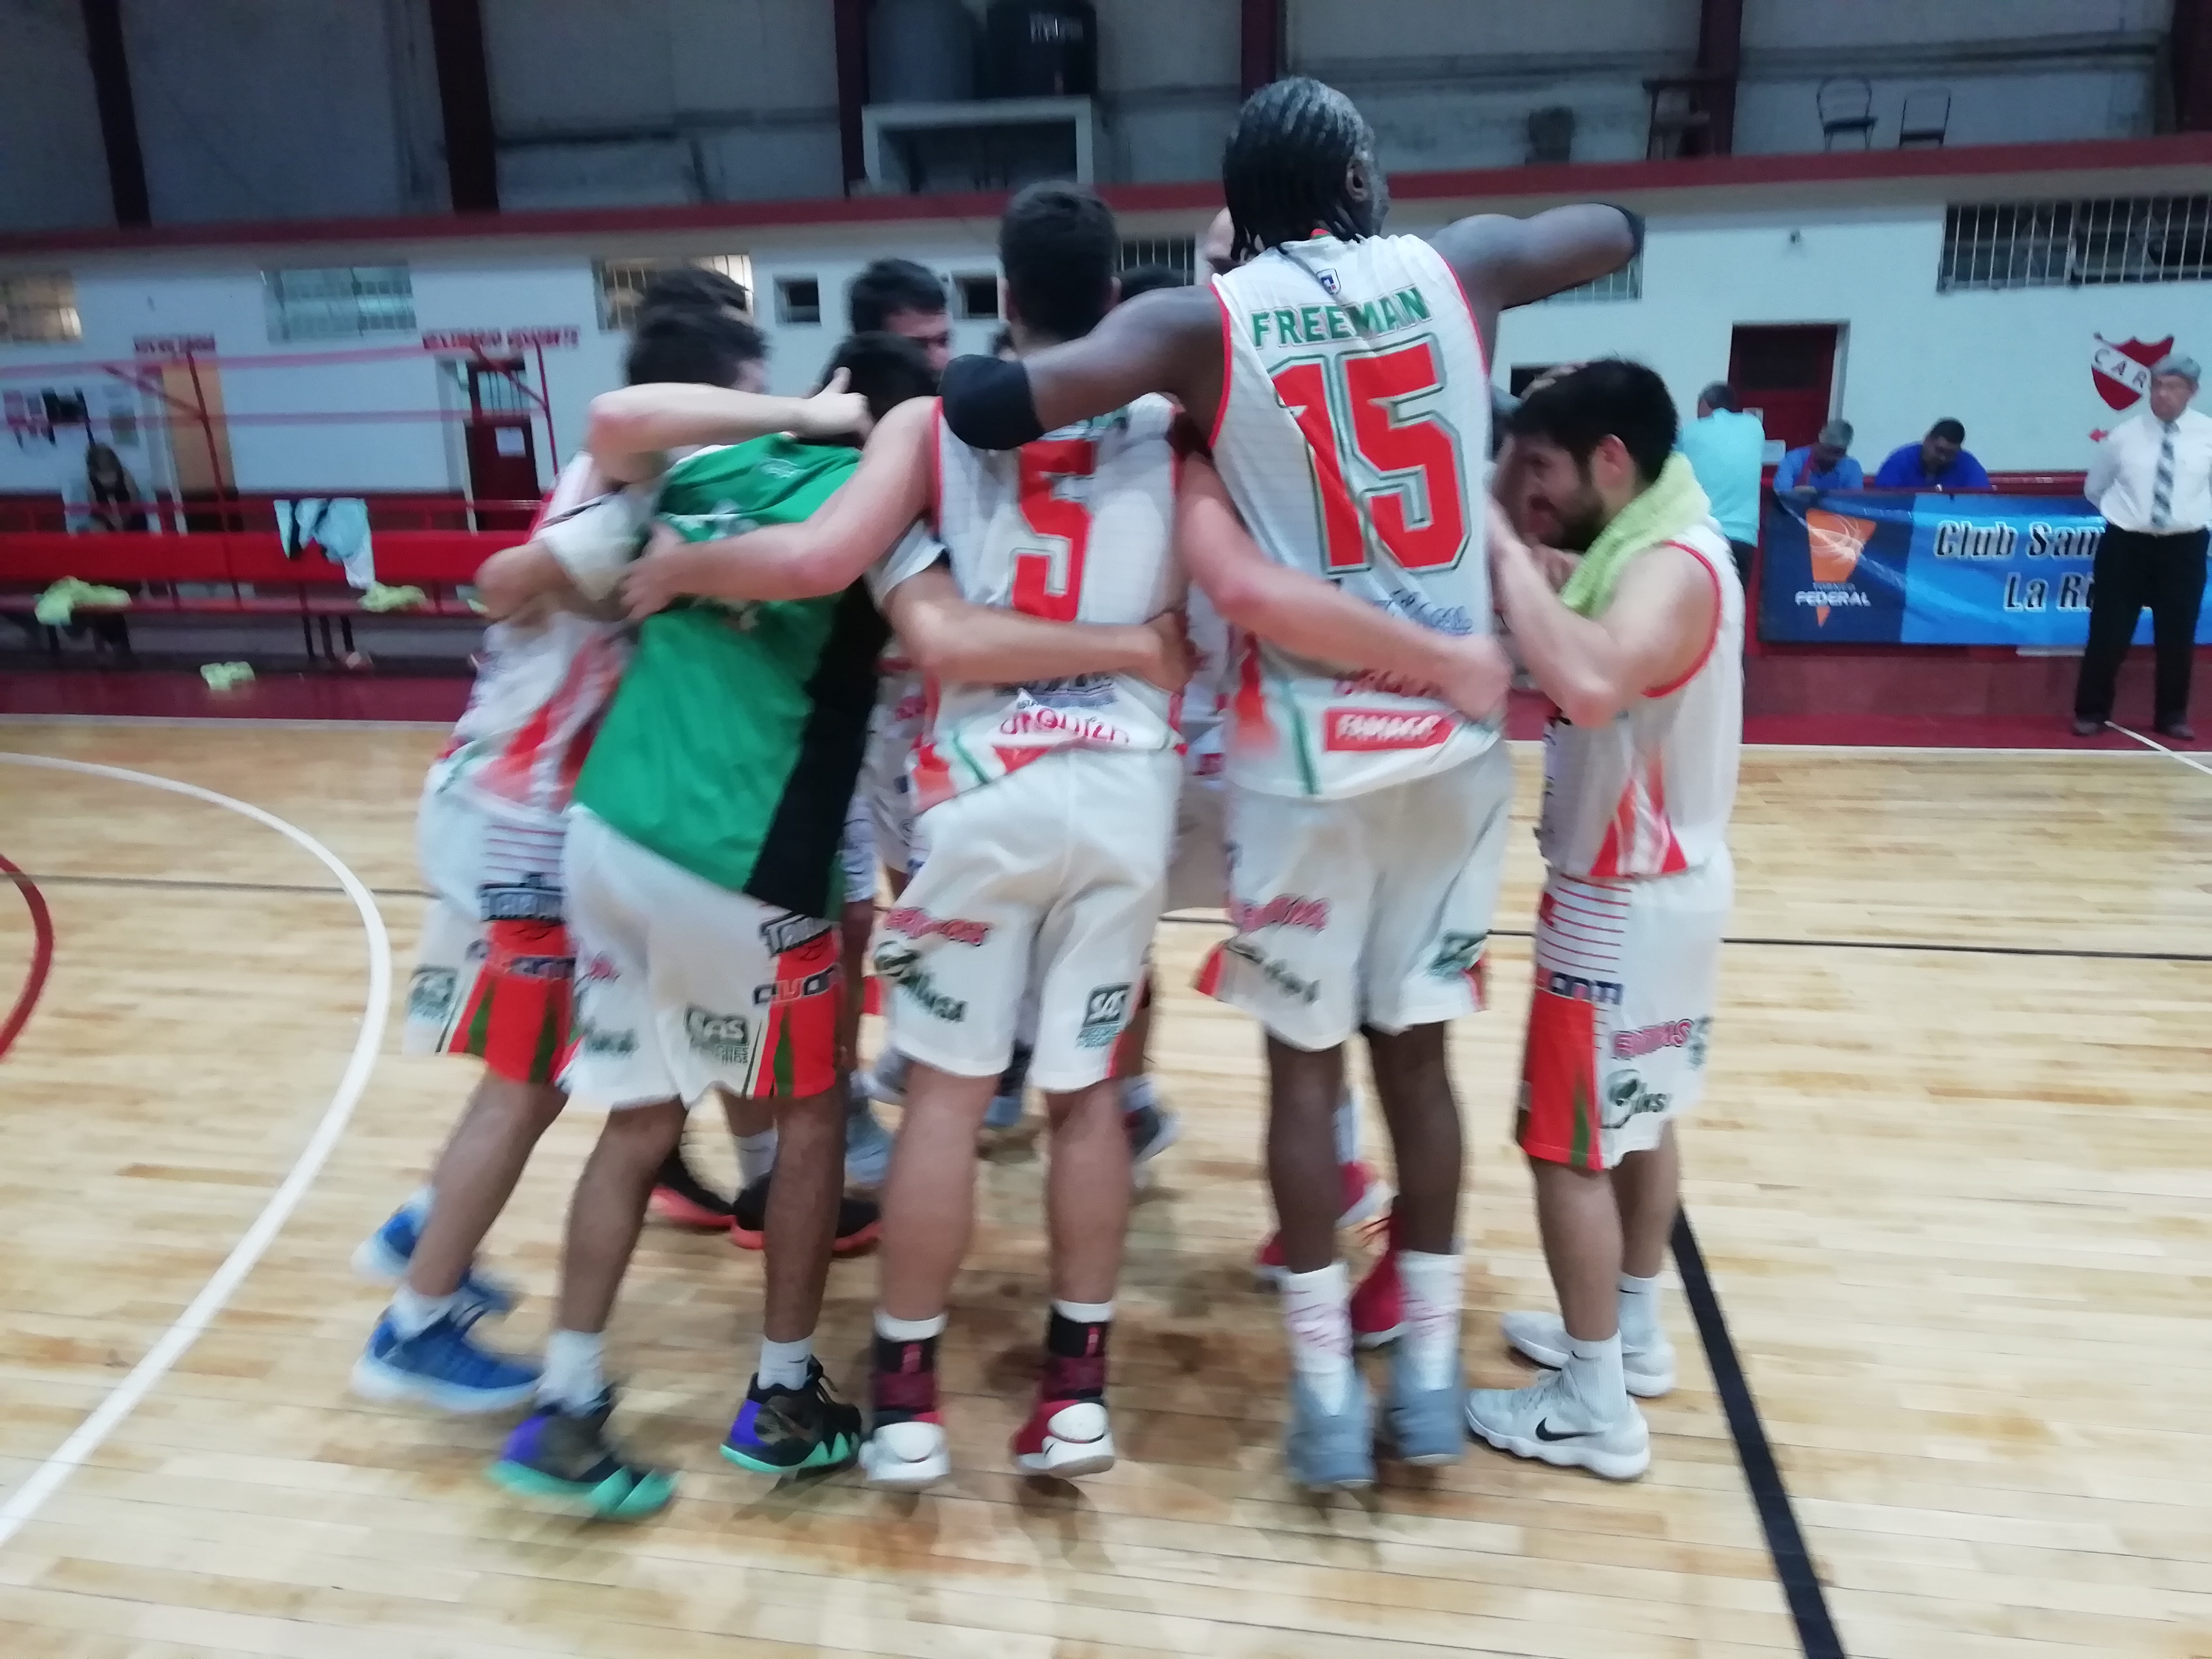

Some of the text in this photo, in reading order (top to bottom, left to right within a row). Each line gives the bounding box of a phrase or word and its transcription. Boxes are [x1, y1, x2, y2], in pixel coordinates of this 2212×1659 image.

[1247, 287, 1431, 347] FREEMAN
[1268, 332, 1472, 577] 15
[1012, 439, 1095, 622] 5
[1933, 520, 2105, 559] Club San
[1795, 591, 1871, 607] FEDERAL
[2004, 572, 2049, 612] La
